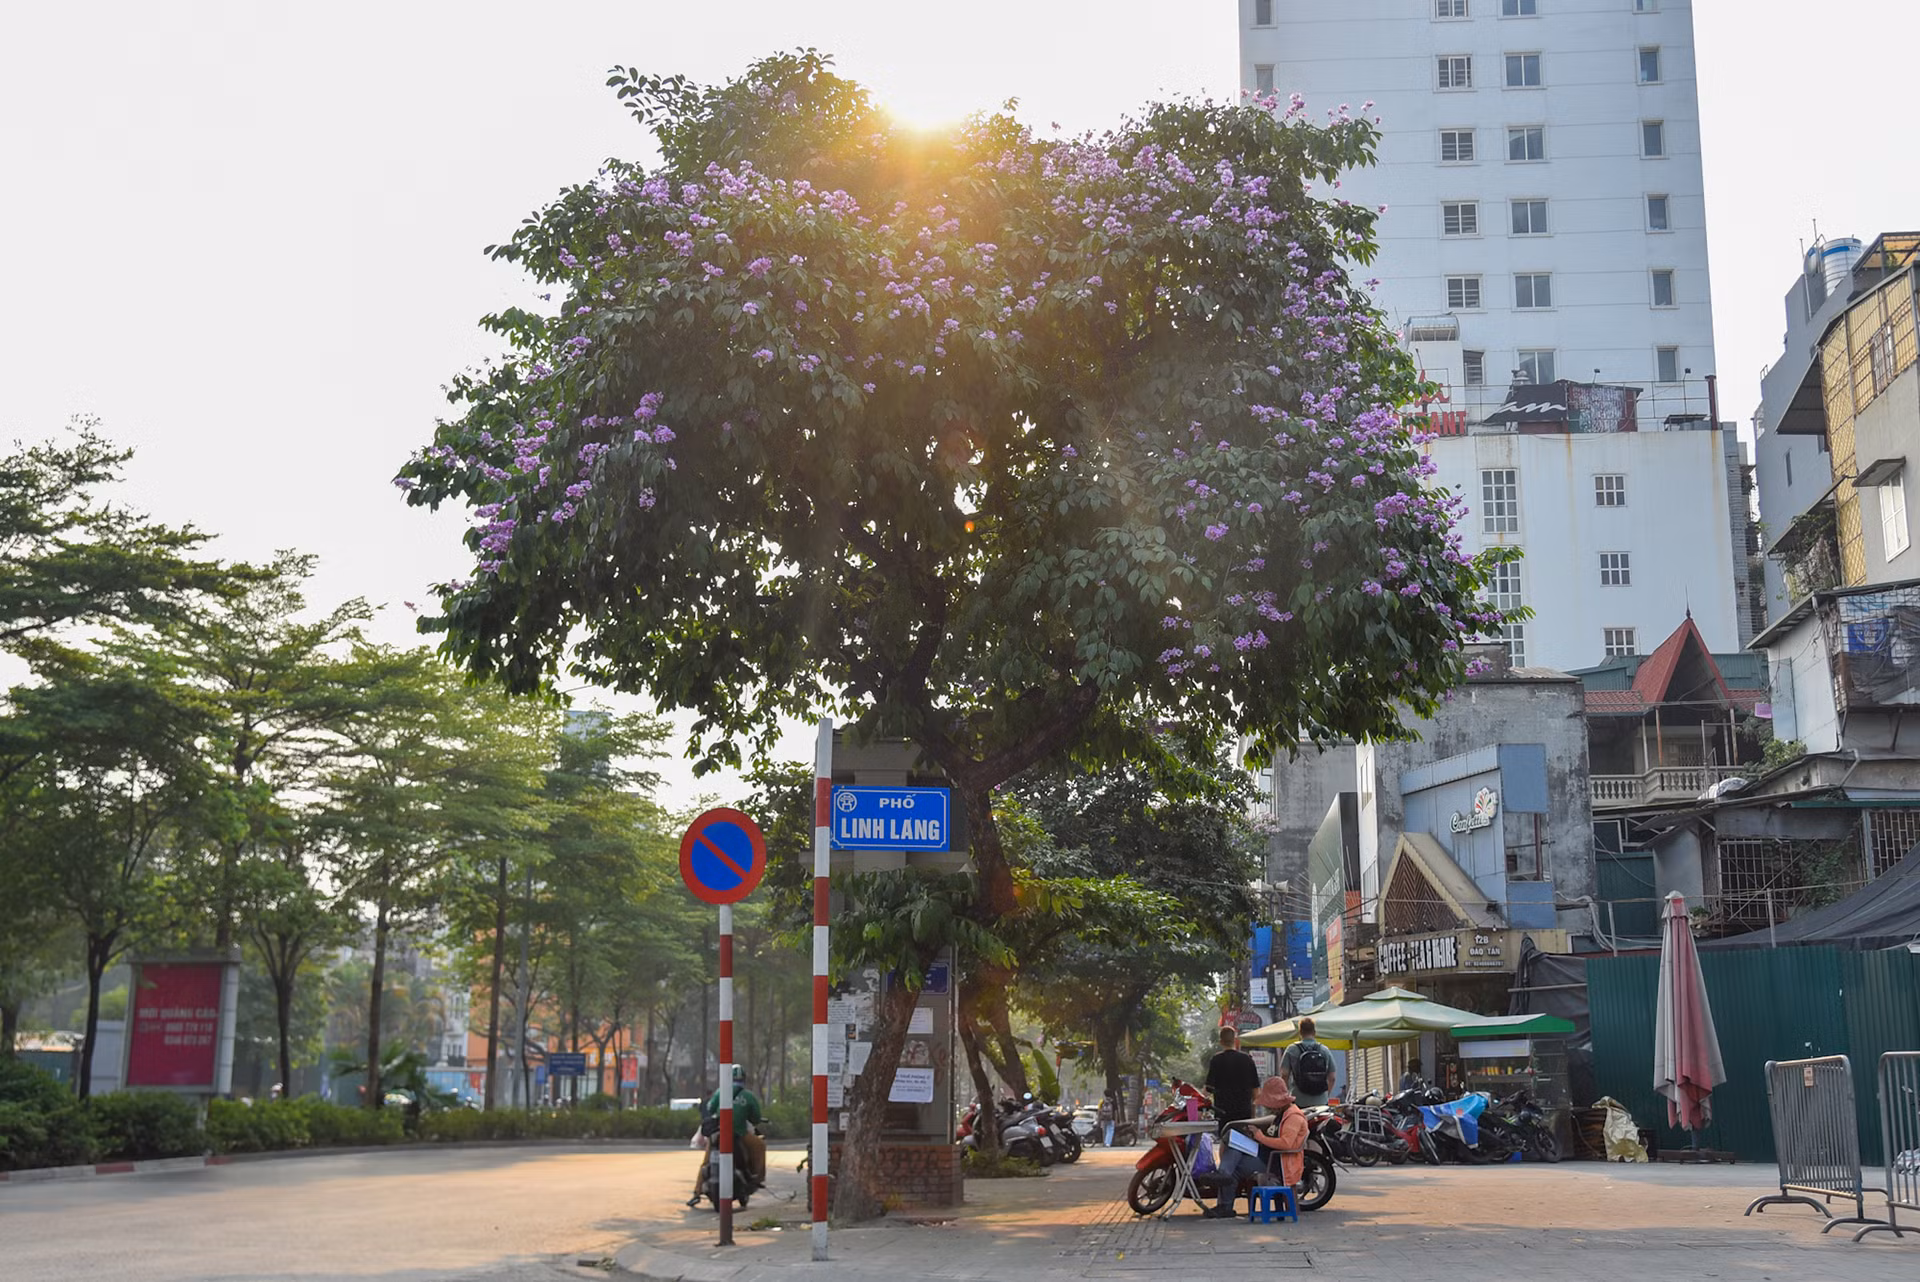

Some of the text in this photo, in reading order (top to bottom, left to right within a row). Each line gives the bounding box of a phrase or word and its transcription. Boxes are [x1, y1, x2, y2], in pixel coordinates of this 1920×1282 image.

[879, 793, 916, 809] PHỐ
[841, 817, 885, 839] LINH
[1474, 934, 1489, 945] 12B
[1378, 942, 1408, 975] COFFEE
